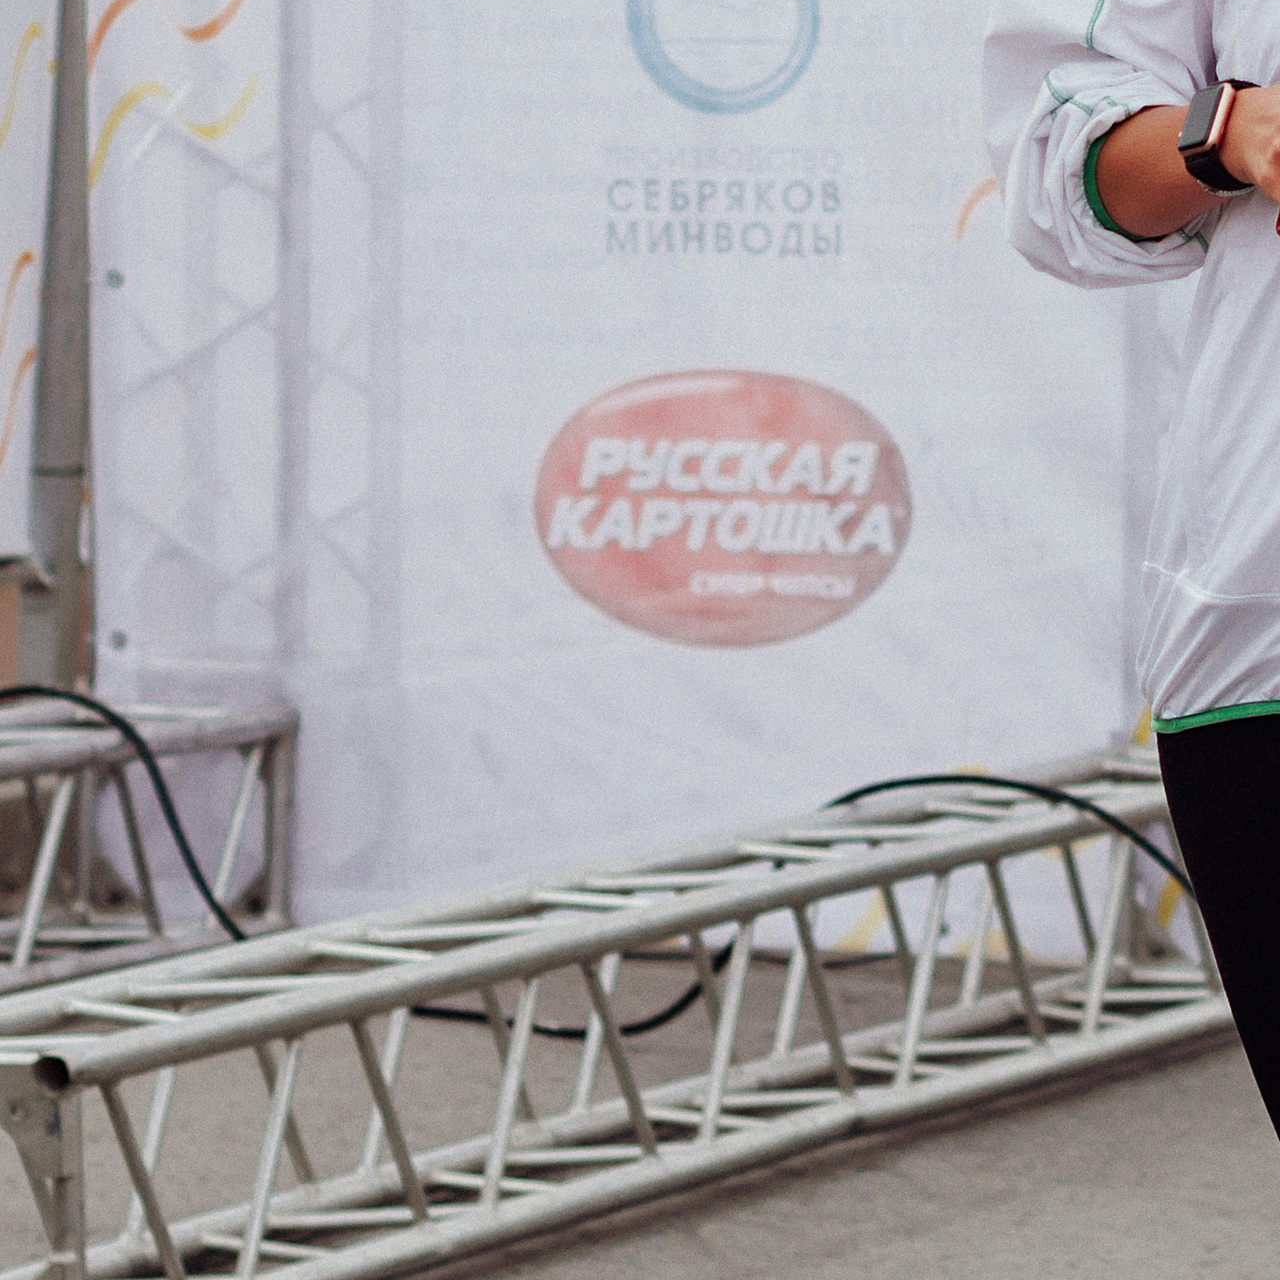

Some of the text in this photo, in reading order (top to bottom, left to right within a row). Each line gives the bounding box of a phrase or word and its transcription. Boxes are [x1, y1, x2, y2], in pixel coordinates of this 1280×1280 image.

[605, 178, 842, 214] СЕБРЯКОВ
[605, 219, 842, 259] МИНВОДЫ
[578, 436, 880, 498] РУССКАЯ
[546, 496, 896, 556] КАРТОШКА
